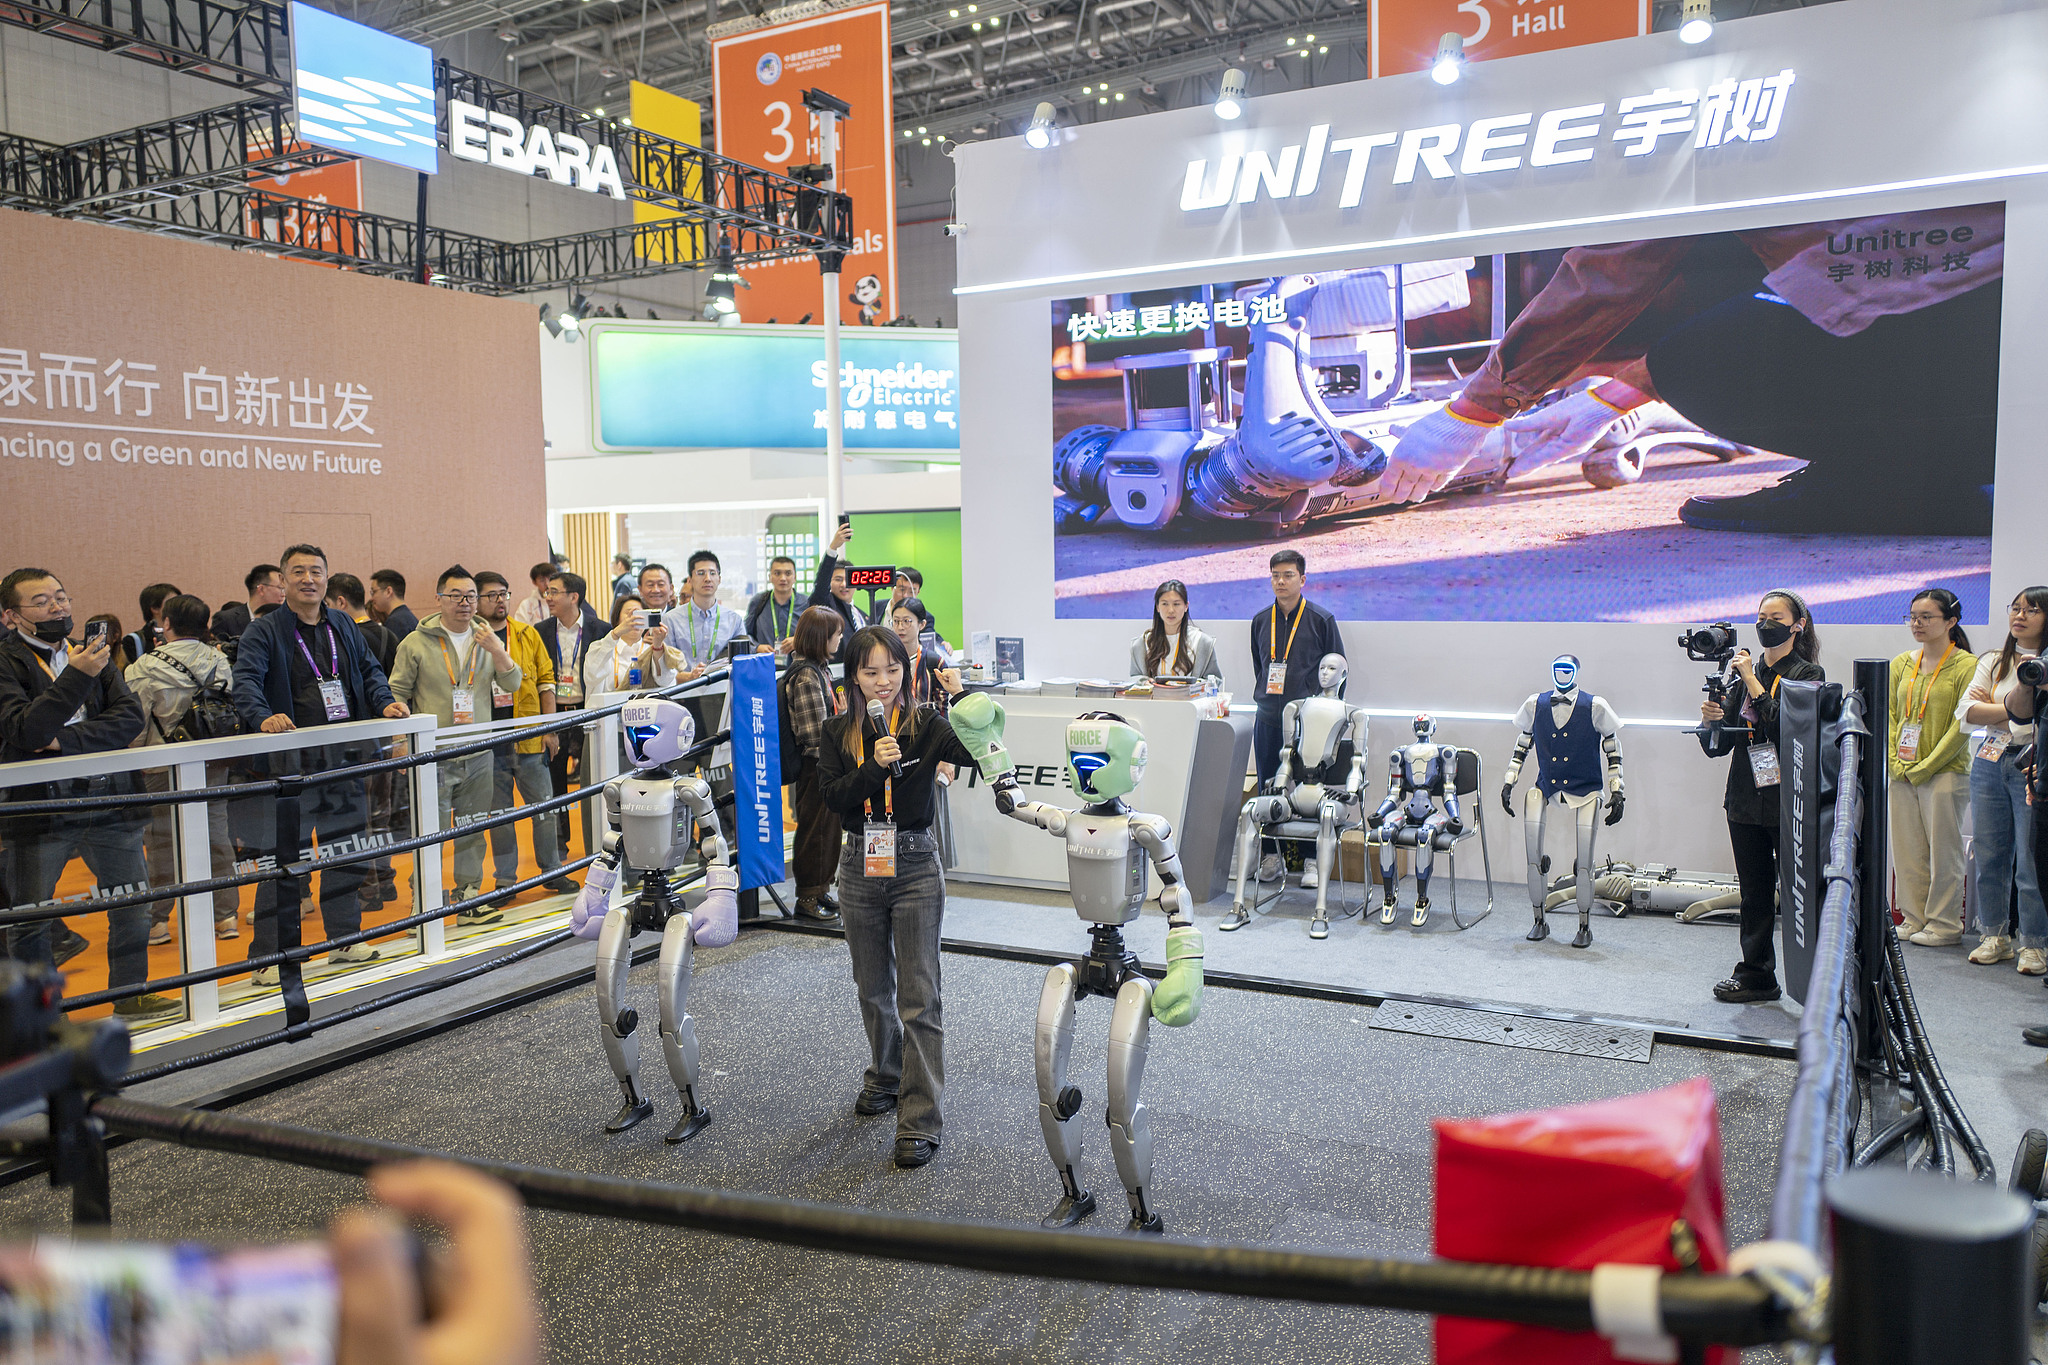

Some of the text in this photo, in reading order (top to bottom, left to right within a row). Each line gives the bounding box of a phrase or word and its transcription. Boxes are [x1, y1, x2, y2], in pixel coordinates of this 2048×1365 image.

[1511, 5, 1566, 38] Hall
[448, 98, 627, 201] EBARA
[763, 101, 794, 163] 3
[1179, 69, 1796, 211] UNITREE 宇树
[307, 226, 331, 244] Hll
[1827, 226, 1974, 255] Unitree
[1827, 251, 1972, 283] 宇树科技
[1066, 294, 1288, 342] 快速更换电池
[183, 366, 375, 435] 向新出发
[874, 389, 952, 406] Electric
[83, 441, 102, 461] a
[110, 437, 193, 466] Green
[200, 445, 248, 469] and
[255, 446, 307, 471] New
[313, 450, 382, 475] Future
[851, 570, 891, 585] 02:26
[624, 707, 651, 722] FORCE
[1069, 730, 1102, 746] FORCE
[751, 696, 771, 843] UNITREE 宇树
[1791, 738, 1807, 949] UNITREE 宇树
